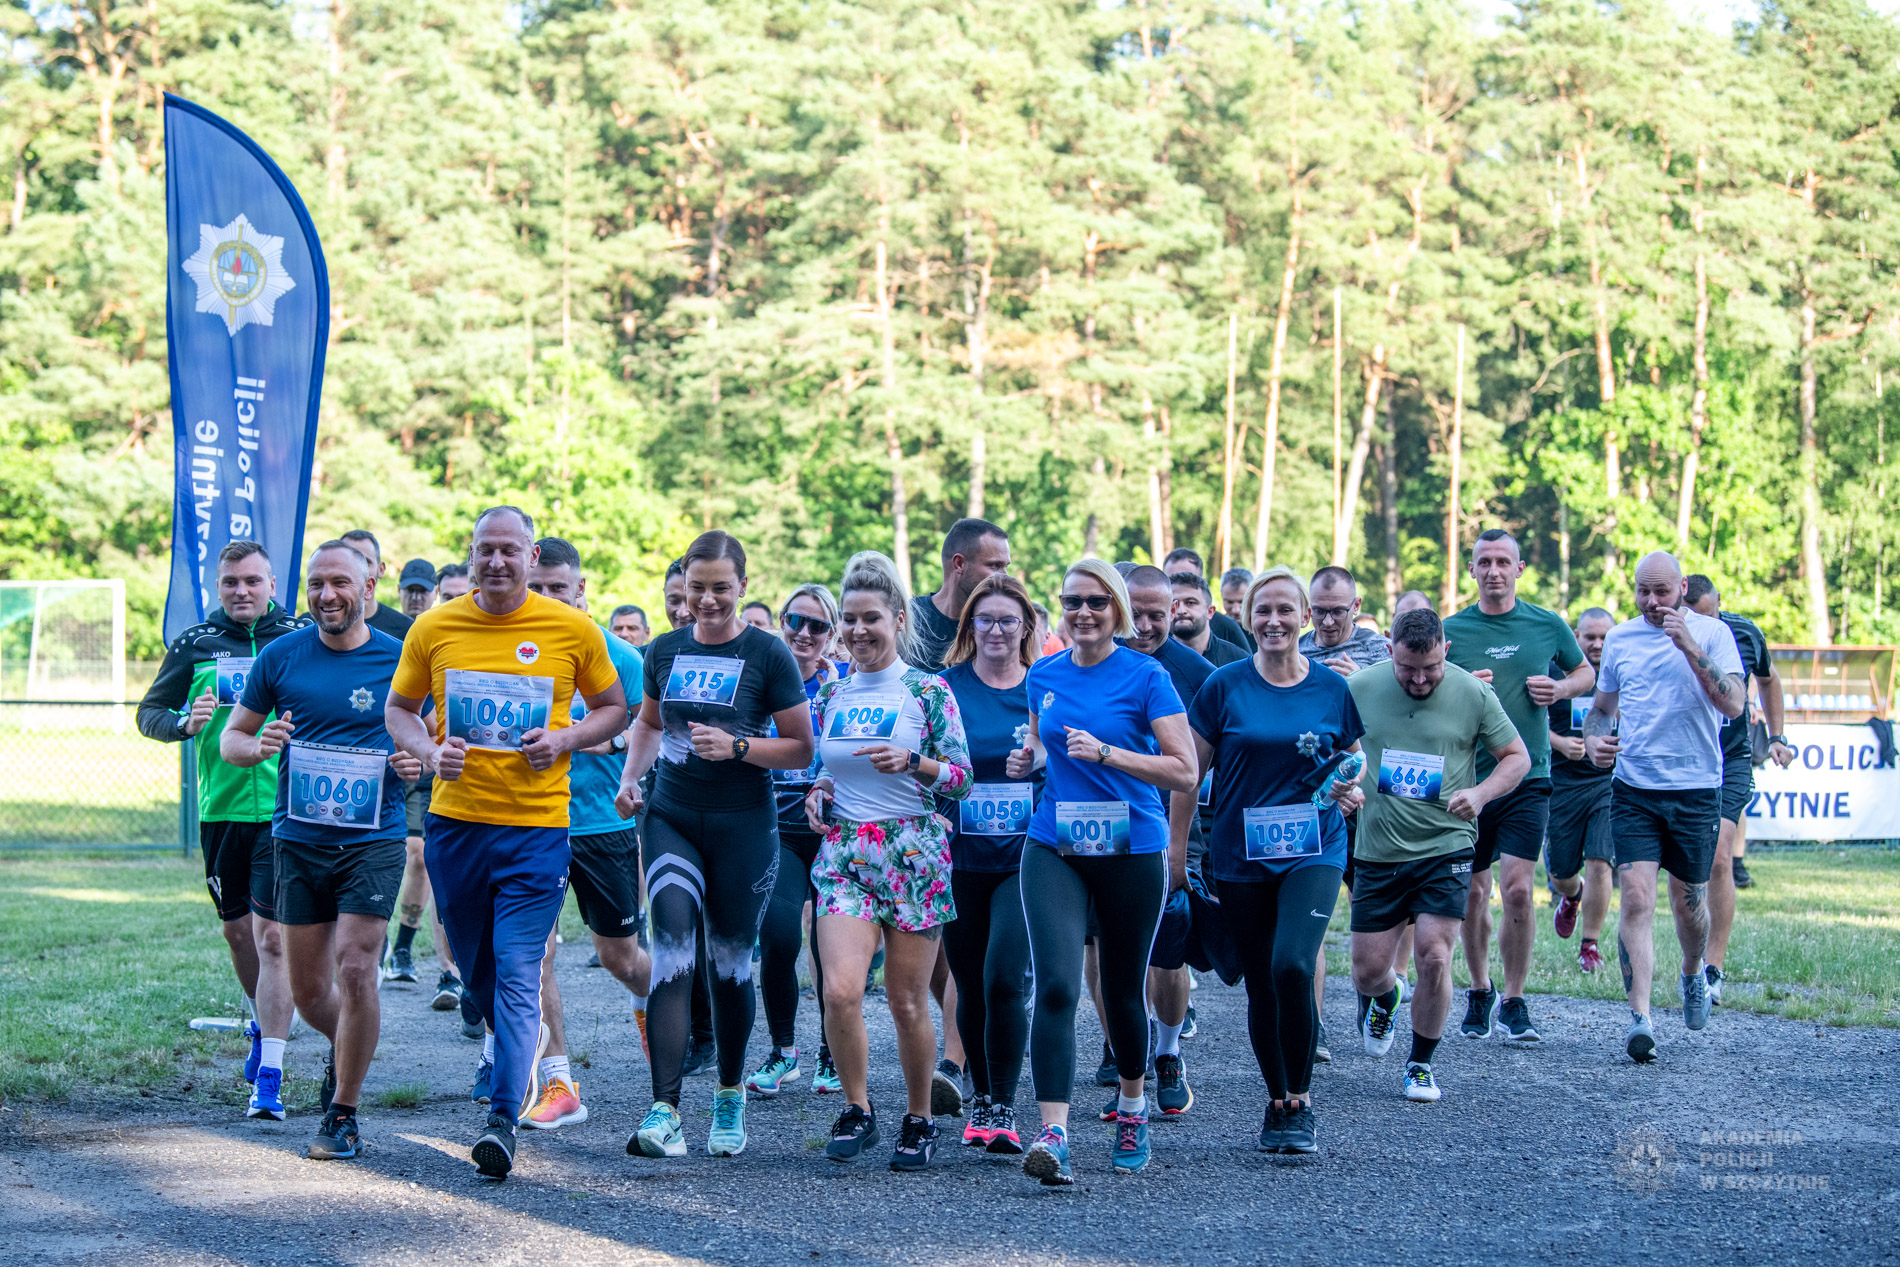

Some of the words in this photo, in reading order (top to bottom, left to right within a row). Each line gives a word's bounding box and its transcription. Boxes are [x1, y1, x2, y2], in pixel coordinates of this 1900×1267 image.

[211, 651, 231, 659] JAKO
[231, 672, 250, 692] 8
[684, 670, 724, 690] 915
[460, 697, 532, 729] 1061
[846, 707, 885, 725] 908
[1391, 765, 1429, 787] 666
[300, 773, 369, 806] 1060
[969, 800, 1024, 821] 1058
[1070, 819, 1112, 841] 001
[1255, 820, 1311, 844] 1057
[370, 893, 384, 902] 4F
